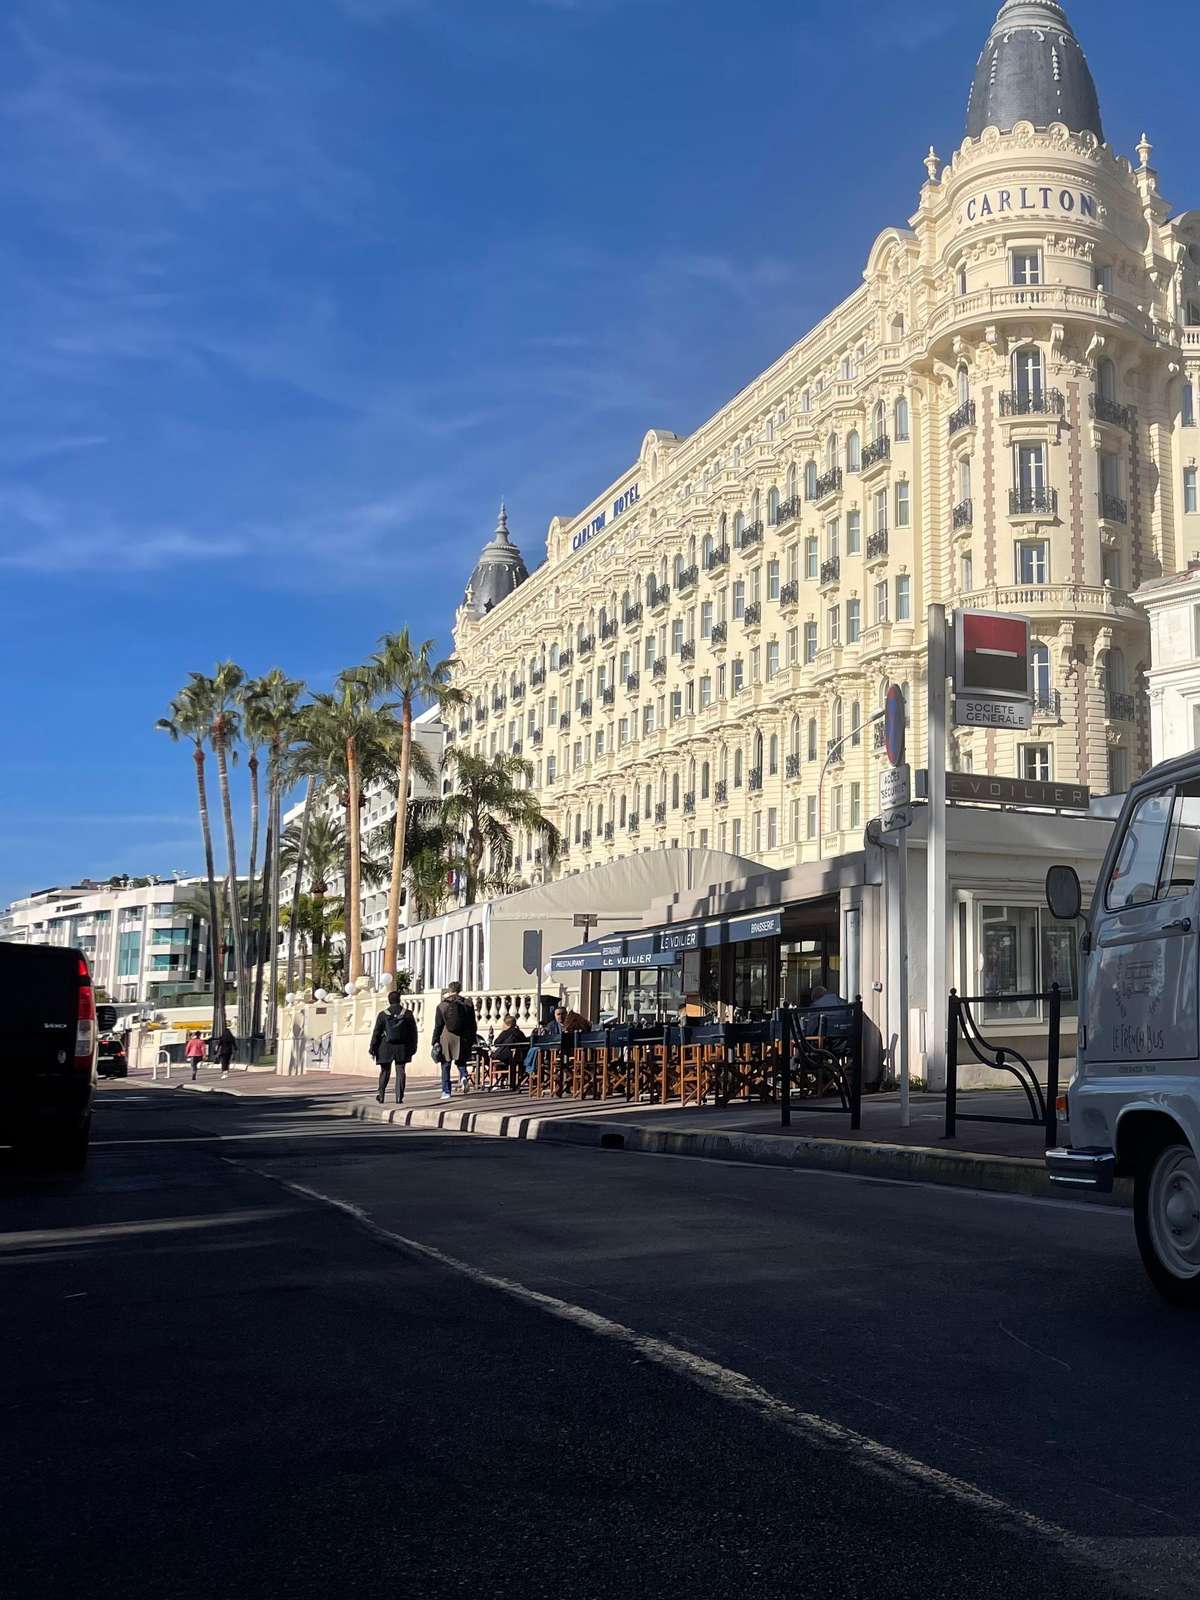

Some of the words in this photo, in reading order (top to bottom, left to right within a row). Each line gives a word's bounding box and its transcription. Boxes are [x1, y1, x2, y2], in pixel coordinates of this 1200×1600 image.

[966, 187, 1094, 221] CARLTON
[572, 511, 606, 551] CARLTON
[613, 483, 640, 517] HOTEL
[970, 783, 1083, 803] VOILIER
[750, 919, 775, 934] BRASSERIE
[660, 936, 669, 950] LE
[670, 933, 696, 948] VOILIER
[556, 959, 585, 968] RESTAURANT
[603, 957, 614, 966] LE
[617, 953, 652, 965] VOILIER
